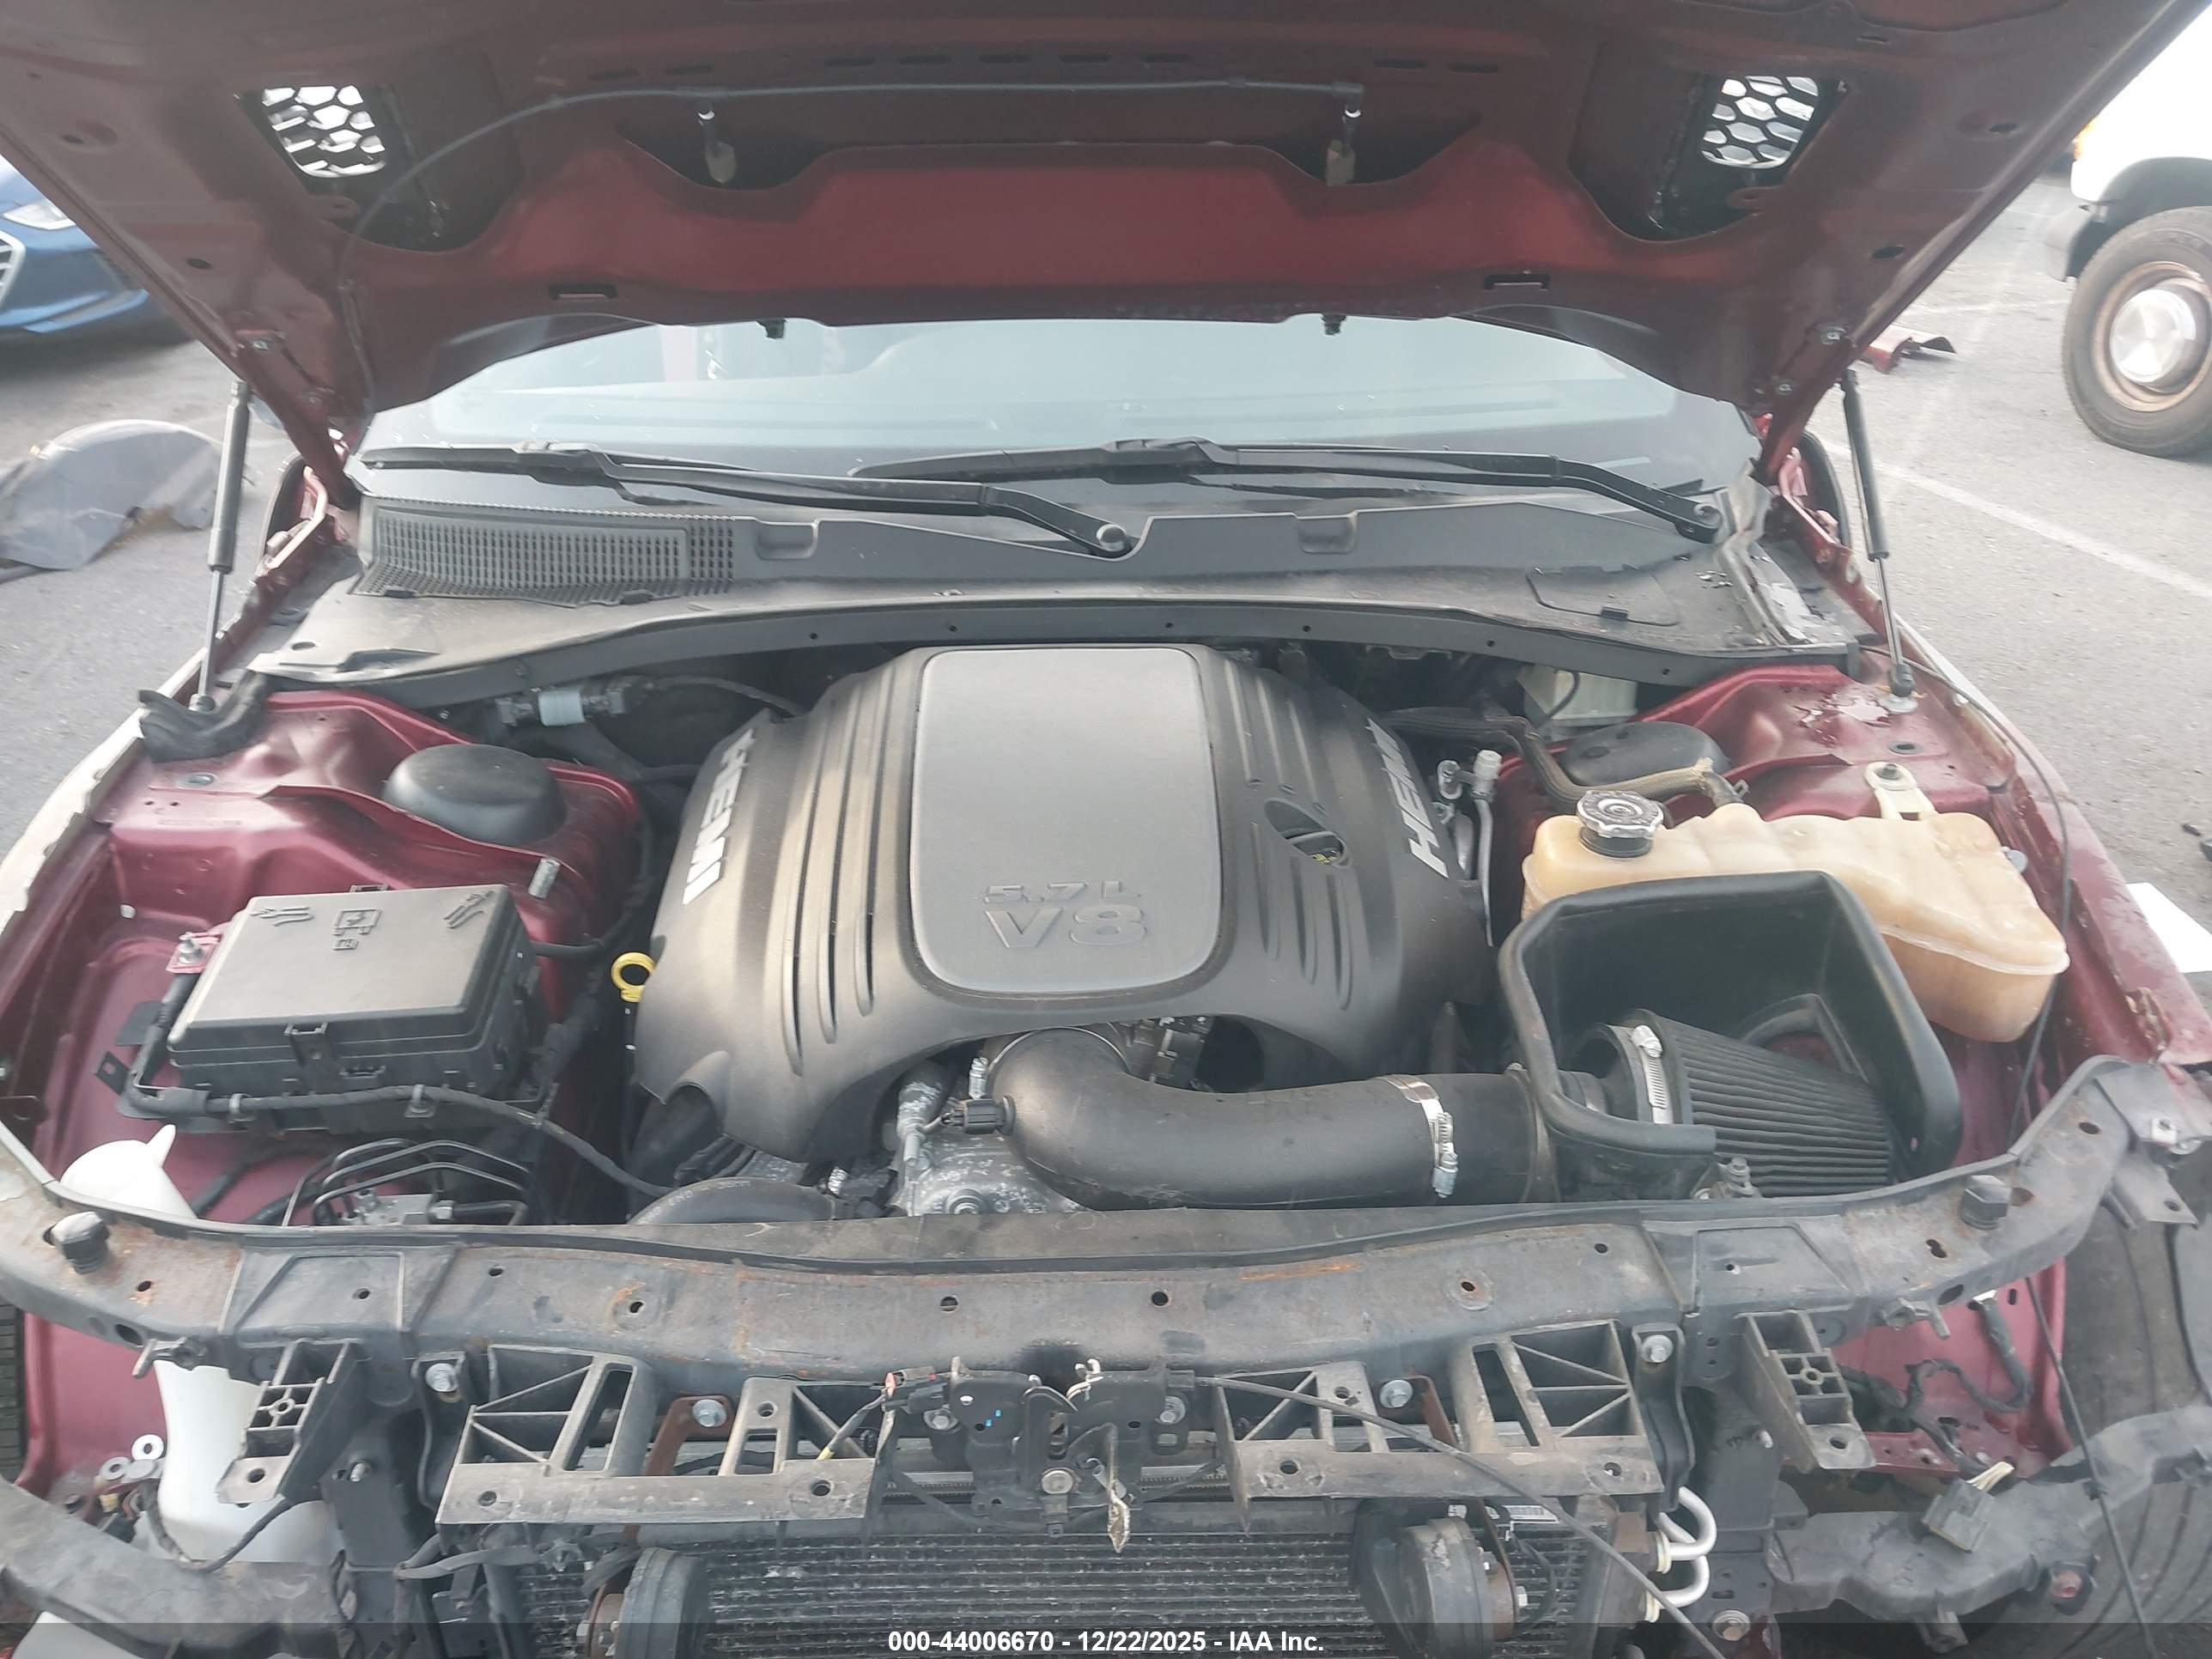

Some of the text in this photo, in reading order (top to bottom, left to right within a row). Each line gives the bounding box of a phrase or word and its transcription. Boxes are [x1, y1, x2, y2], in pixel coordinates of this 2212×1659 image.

[683, 728, 757, 905] HEMI
[1364, 717, 1449, 878] HEMI
[985, 903, 1148, 948] V8
